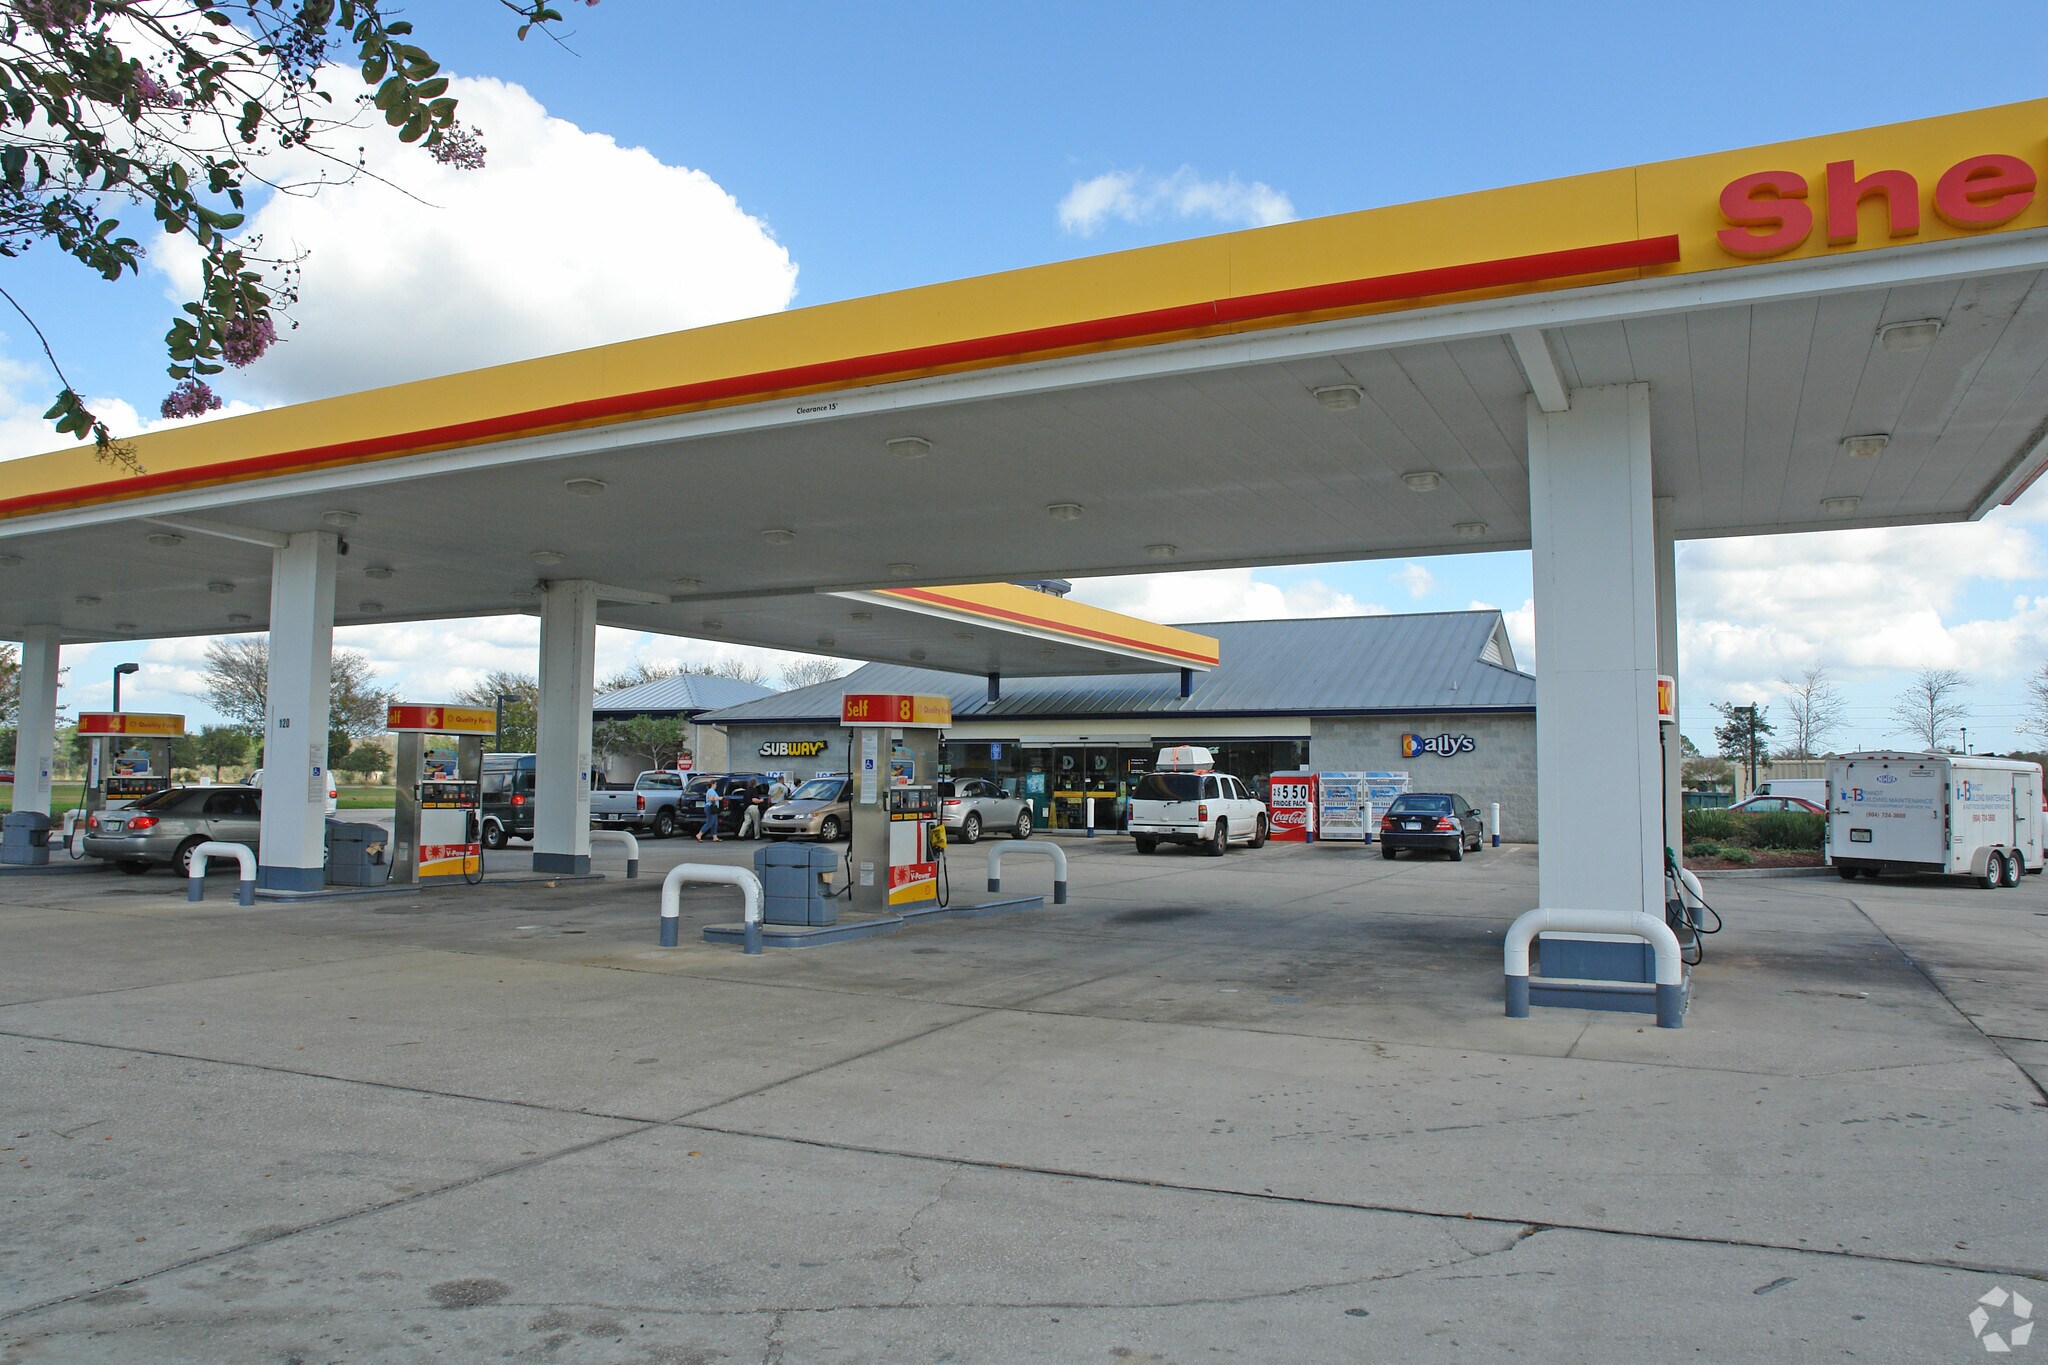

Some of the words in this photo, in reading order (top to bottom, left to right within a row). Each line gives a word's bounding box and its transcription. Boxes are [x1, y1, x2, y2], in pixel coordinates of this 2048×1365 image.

[1716, 152, 2048, 260] she
[796, 405, 828, 415] Clearance
[1657, 685, 1672, 712] 10
[847, 699, 869, 718] Self
[899, 699, 911, 720] 8
[108, 716, 122, 731] 4
[138, 721, 161, 729] Quality
[279, 718, 290, 729] 120
[425, 709, 439, 727] 6
[455, 715, 478, 725] Quality
[758, 740, 826, 757] SUBWAY
[1402, 733, 1475, 758] Daily's
[910, 872, 931, 880] V-Power
